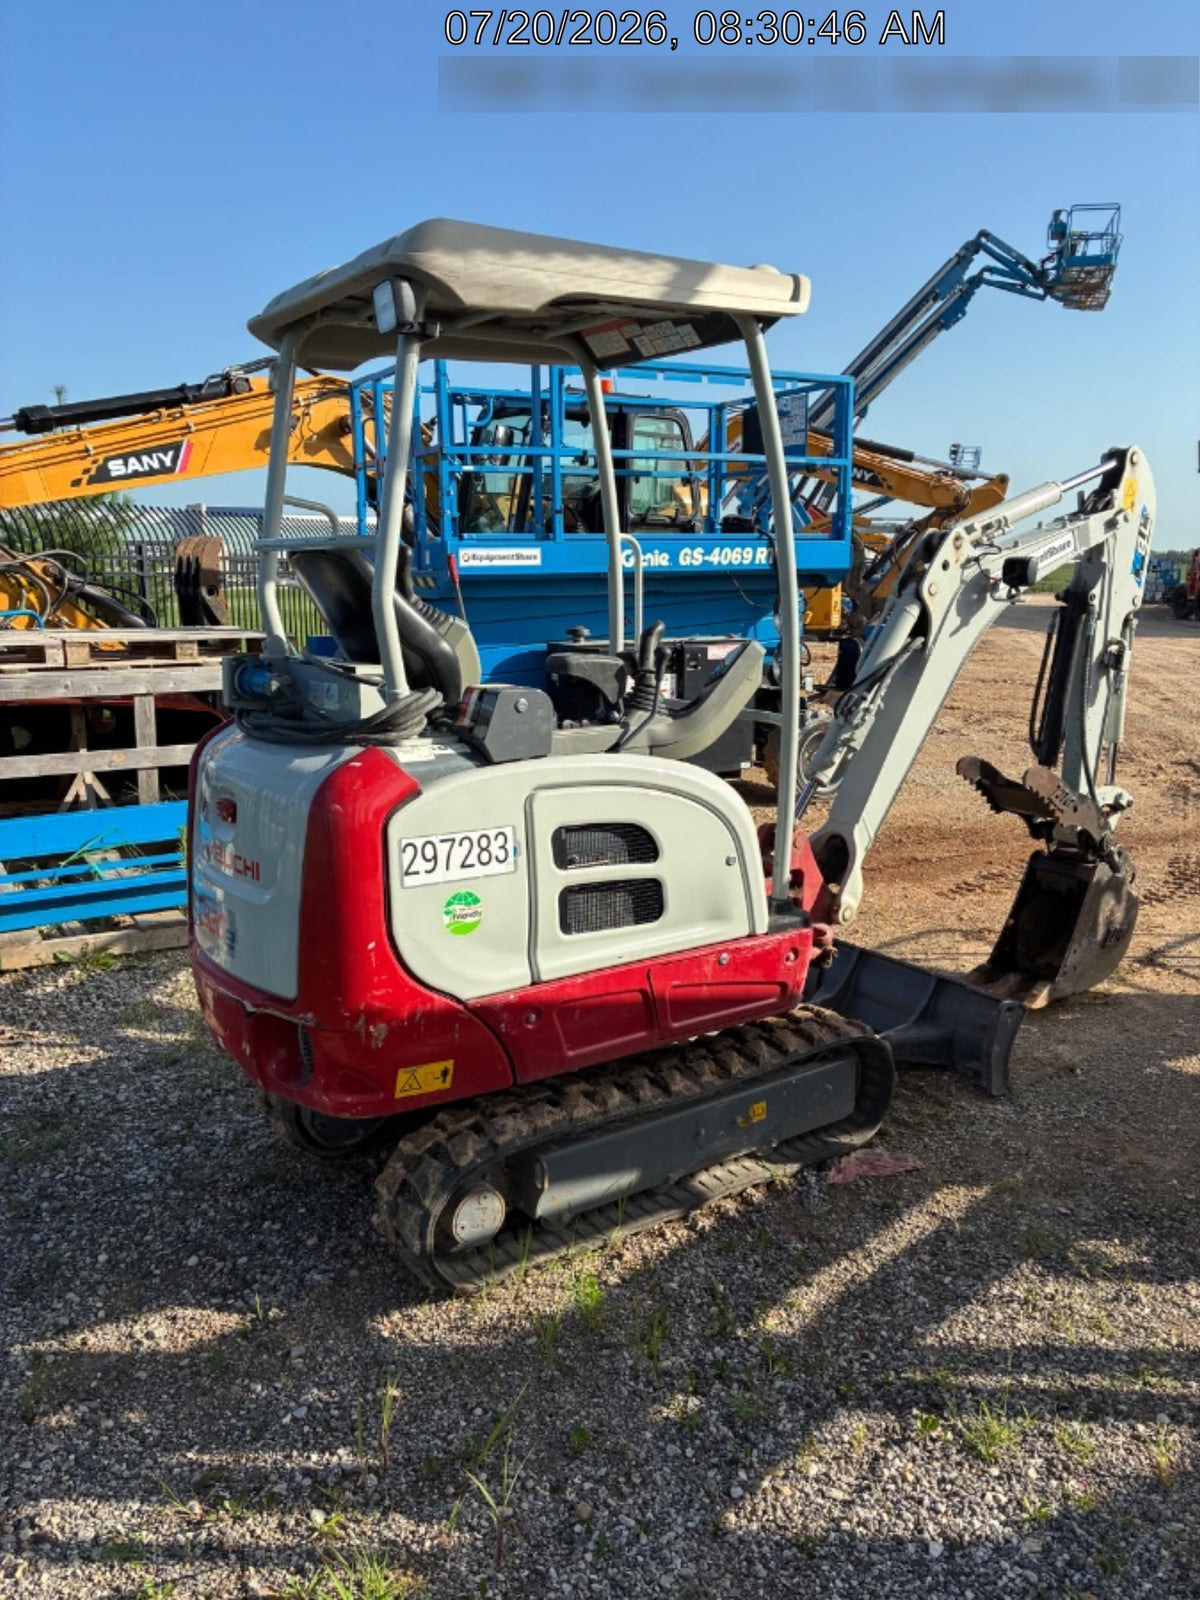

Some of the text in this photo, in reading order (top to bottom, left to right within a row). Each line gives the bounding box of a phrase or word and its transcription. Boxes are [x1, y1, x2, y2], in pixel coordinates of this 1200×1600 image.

[107, 449, 174, 477] SANY
[471, 552, 538, 563] EquipmentShare
[678, 547, 752, 566] GS-4069
[402, 831, 509, 876] 297283
